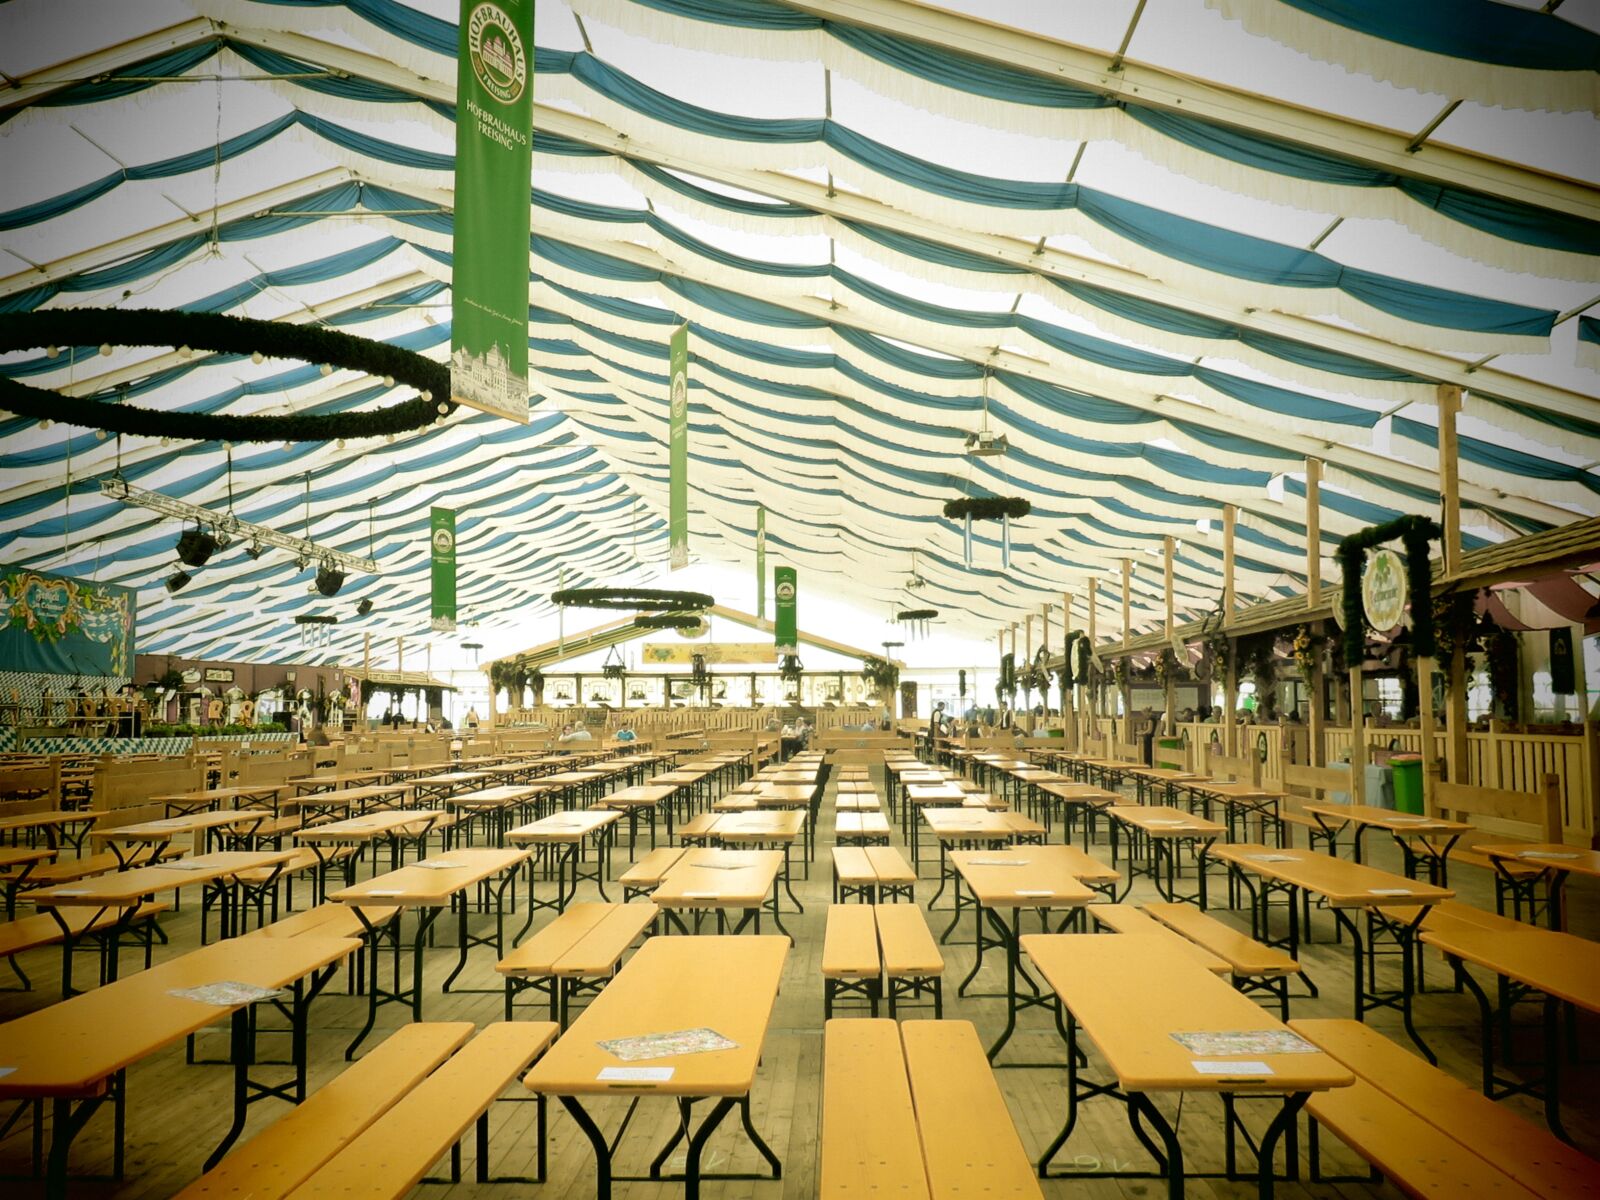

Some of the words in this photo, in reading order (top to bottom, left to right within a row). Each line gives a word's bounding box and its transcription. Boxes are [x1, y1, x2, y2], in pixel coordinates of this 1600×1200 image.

[483, 74, 511, 99] FREISING
[466, 99, 527, 146] HOFBRAUHAUS
[478, 121, 513, 151] FREISING
